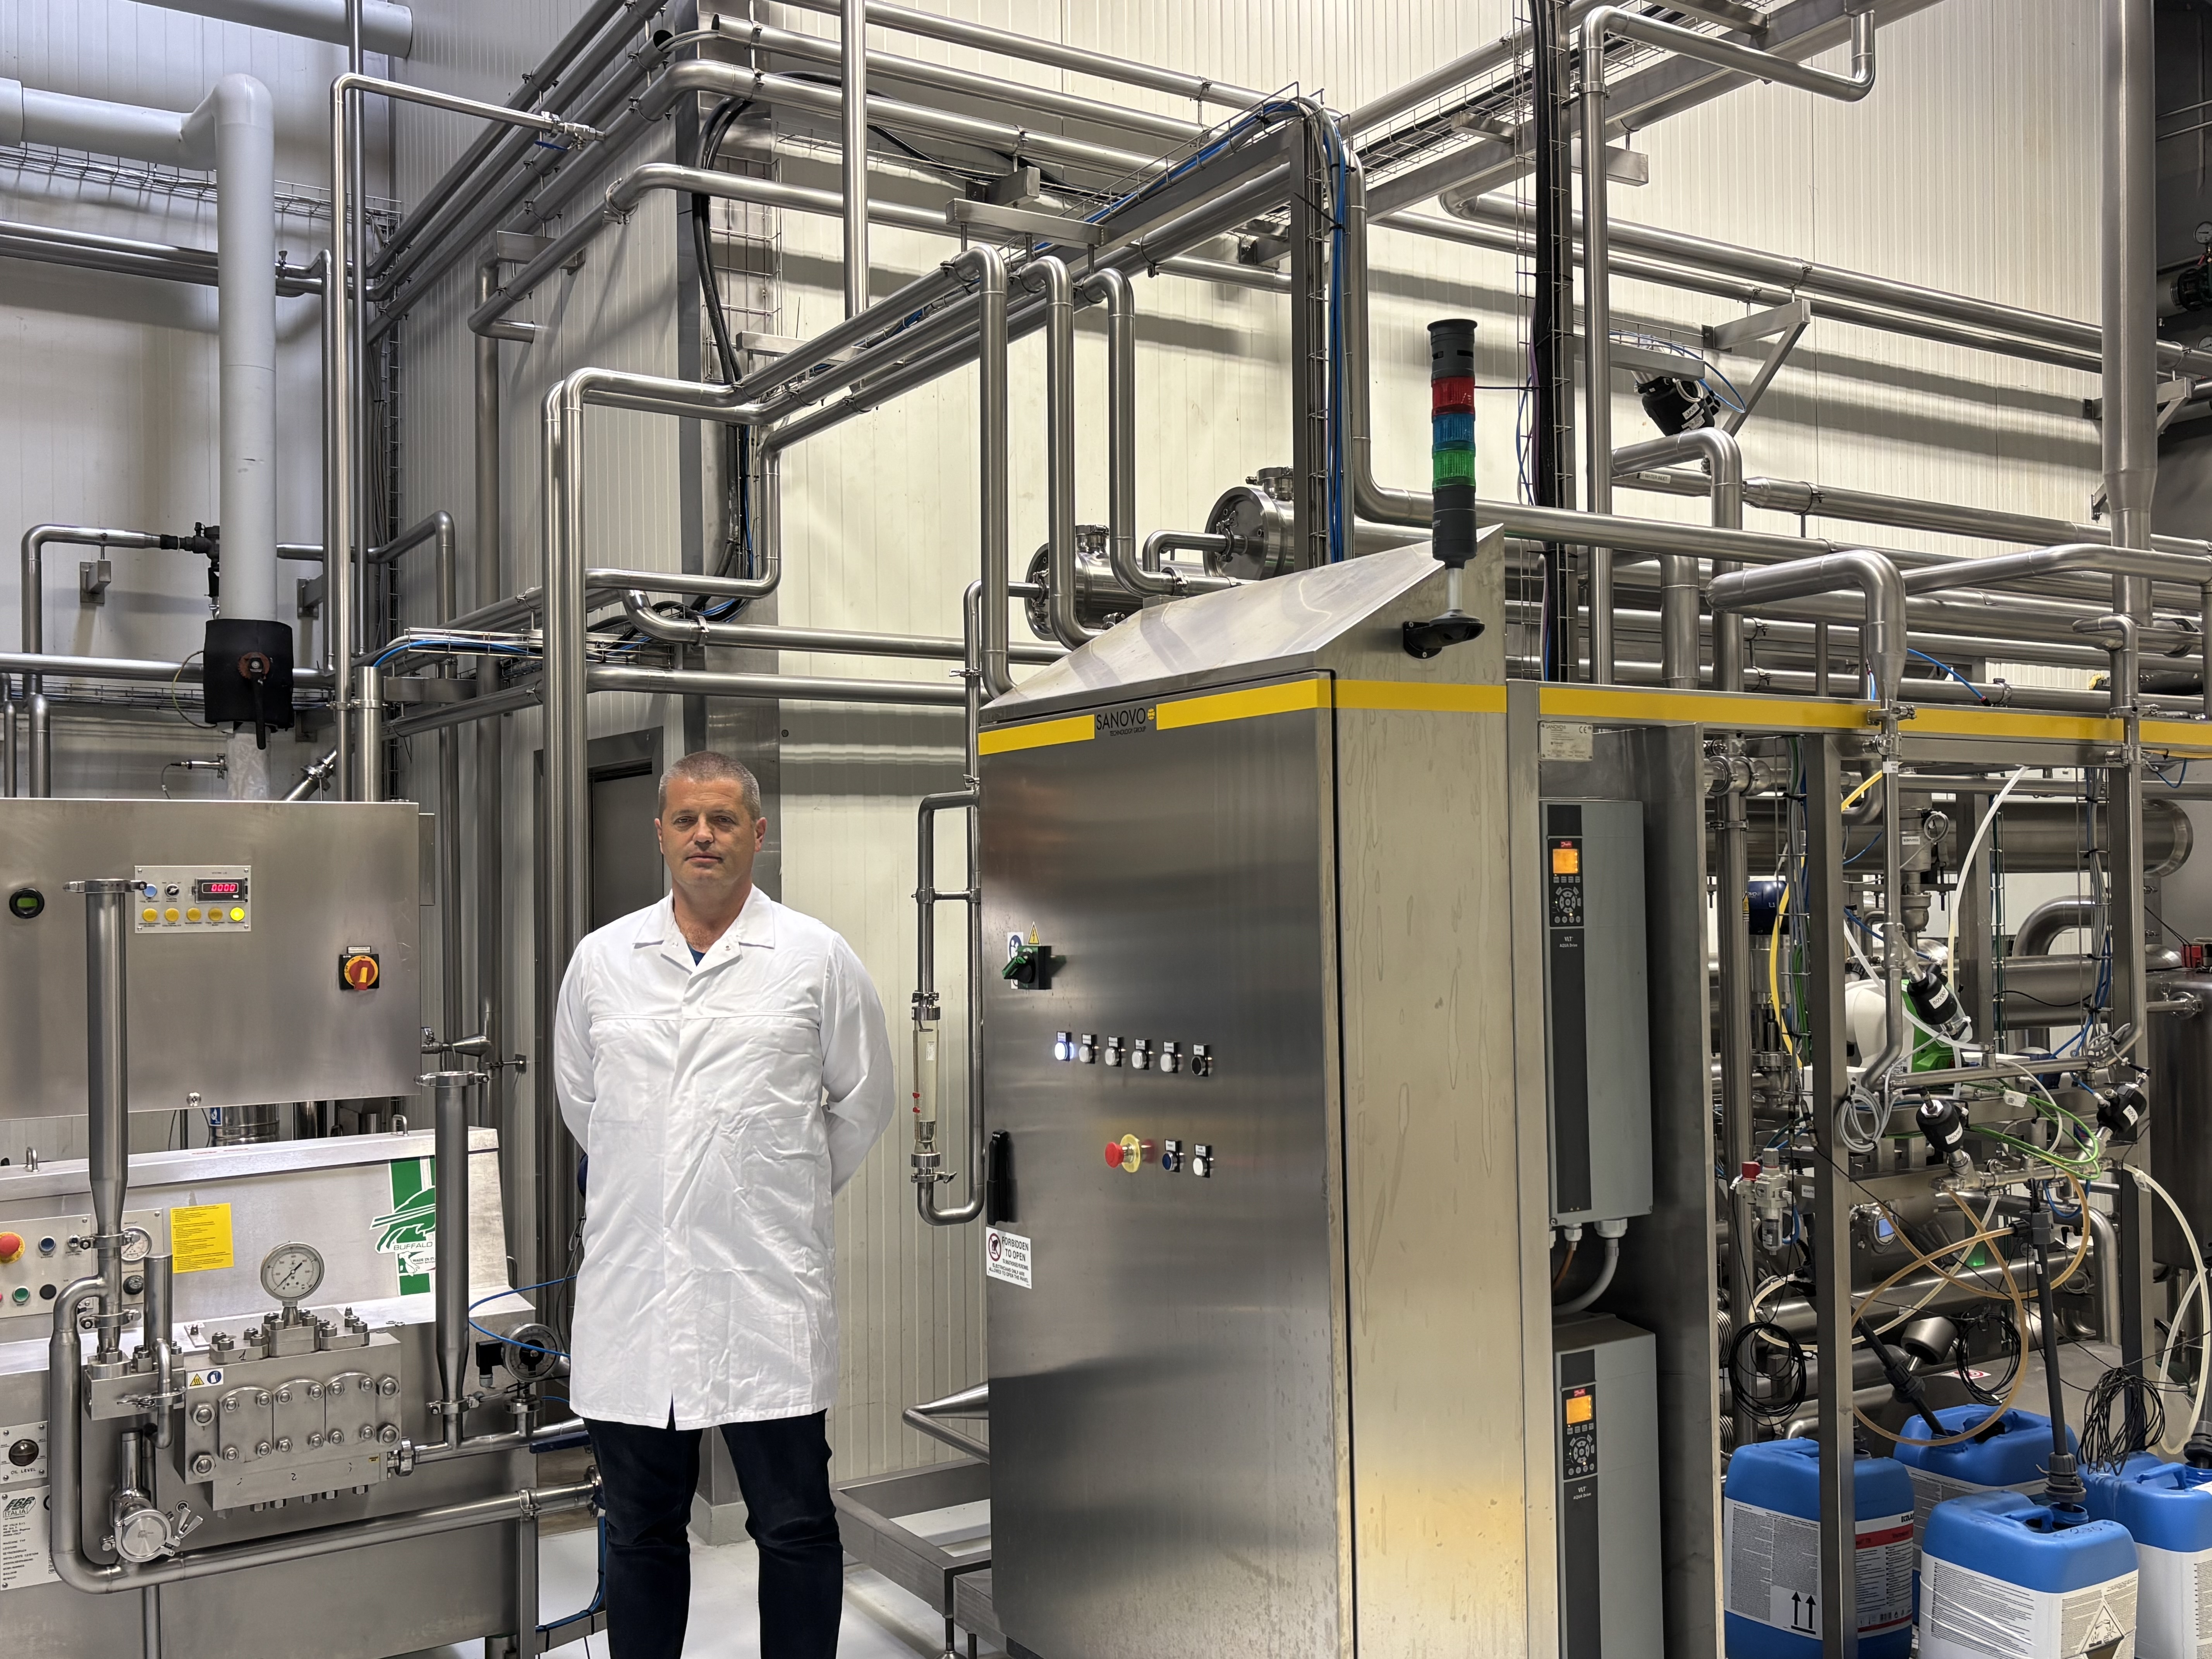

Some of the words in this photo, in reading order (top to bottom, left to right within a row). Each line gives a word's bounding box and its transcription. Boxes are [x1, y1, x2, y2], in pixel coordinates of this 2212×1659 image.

[1096, 708, 1146, 730] SANOVO
[1110, 728, 1133, 736] TECHNOLOGY
[394, 1242, 433, 1250] BUFFALO
[1002, 1236, 1029, 1251] FORBIDDEN
[1005, 1248, 1012, 1258] TO
[1012, 1250, 1026, 1262] OPEN
[5, 1509, 26, 1517] ITALIA
[1901, 1513, 1914, 1522] ECOLA
